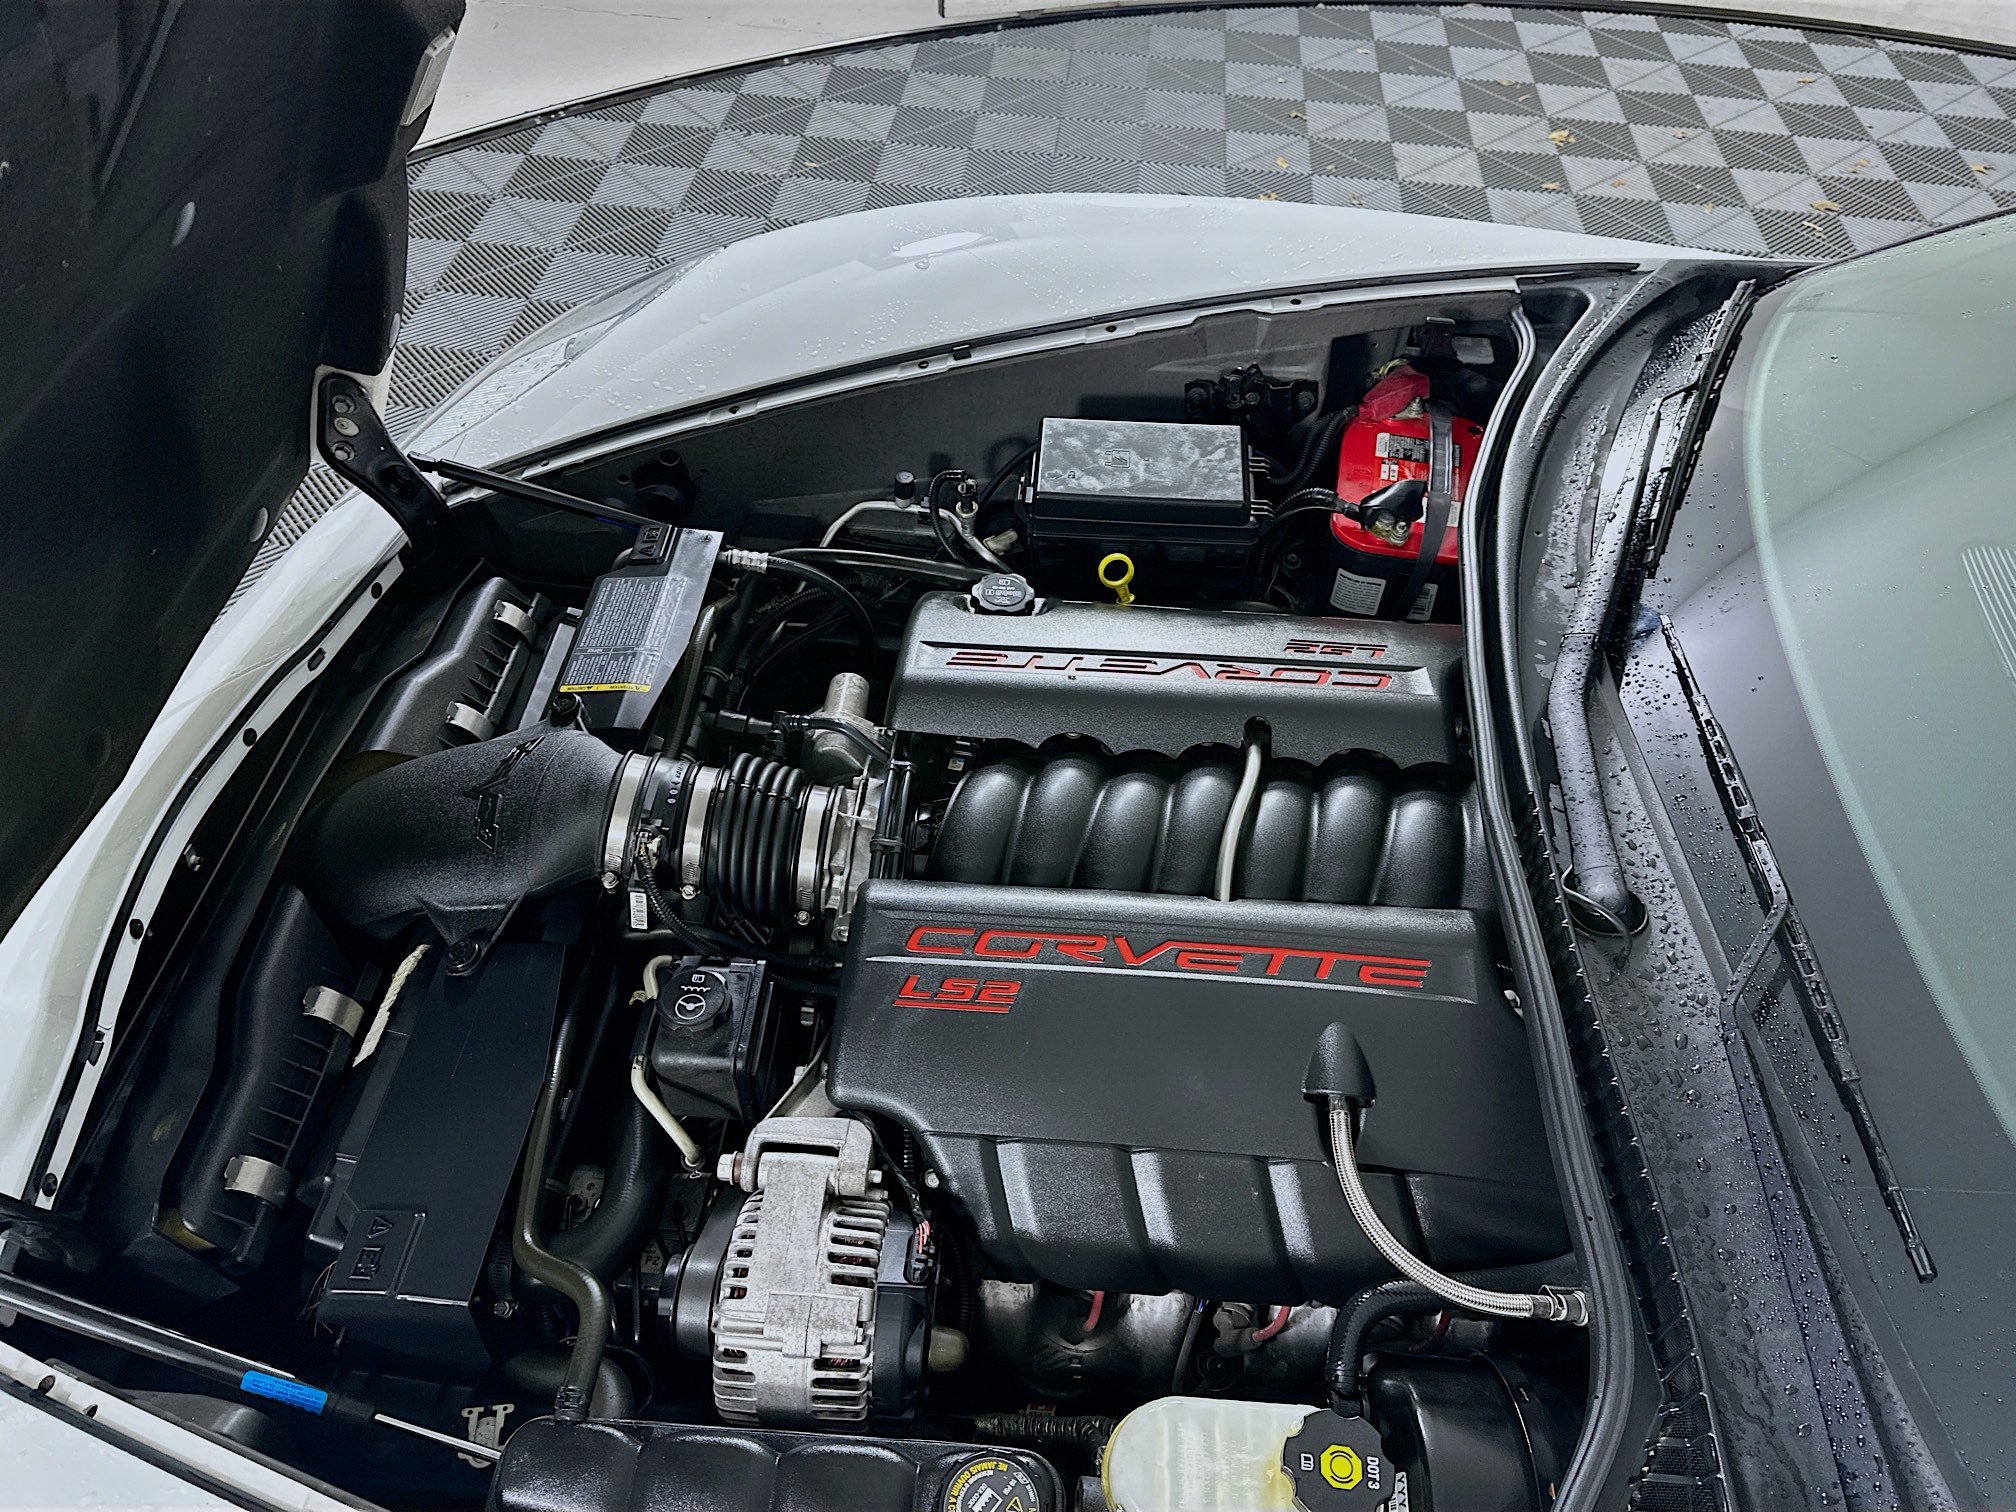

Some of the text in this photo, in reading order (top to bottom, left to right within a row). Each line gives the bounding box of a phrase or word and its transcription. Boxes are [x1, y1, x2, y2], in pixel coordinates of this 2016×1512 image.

[1283, 641, 1386, 658] LS2
[945, 651, 1393, 689] CORVETTE
[905, 925, 1432, 989] CORVETTE
[898, 975, 1022, 1002] LS2
[970, 1461, 997, 1475] JAMAIS
[951, 1471, 971, 1497] OUVRIR
